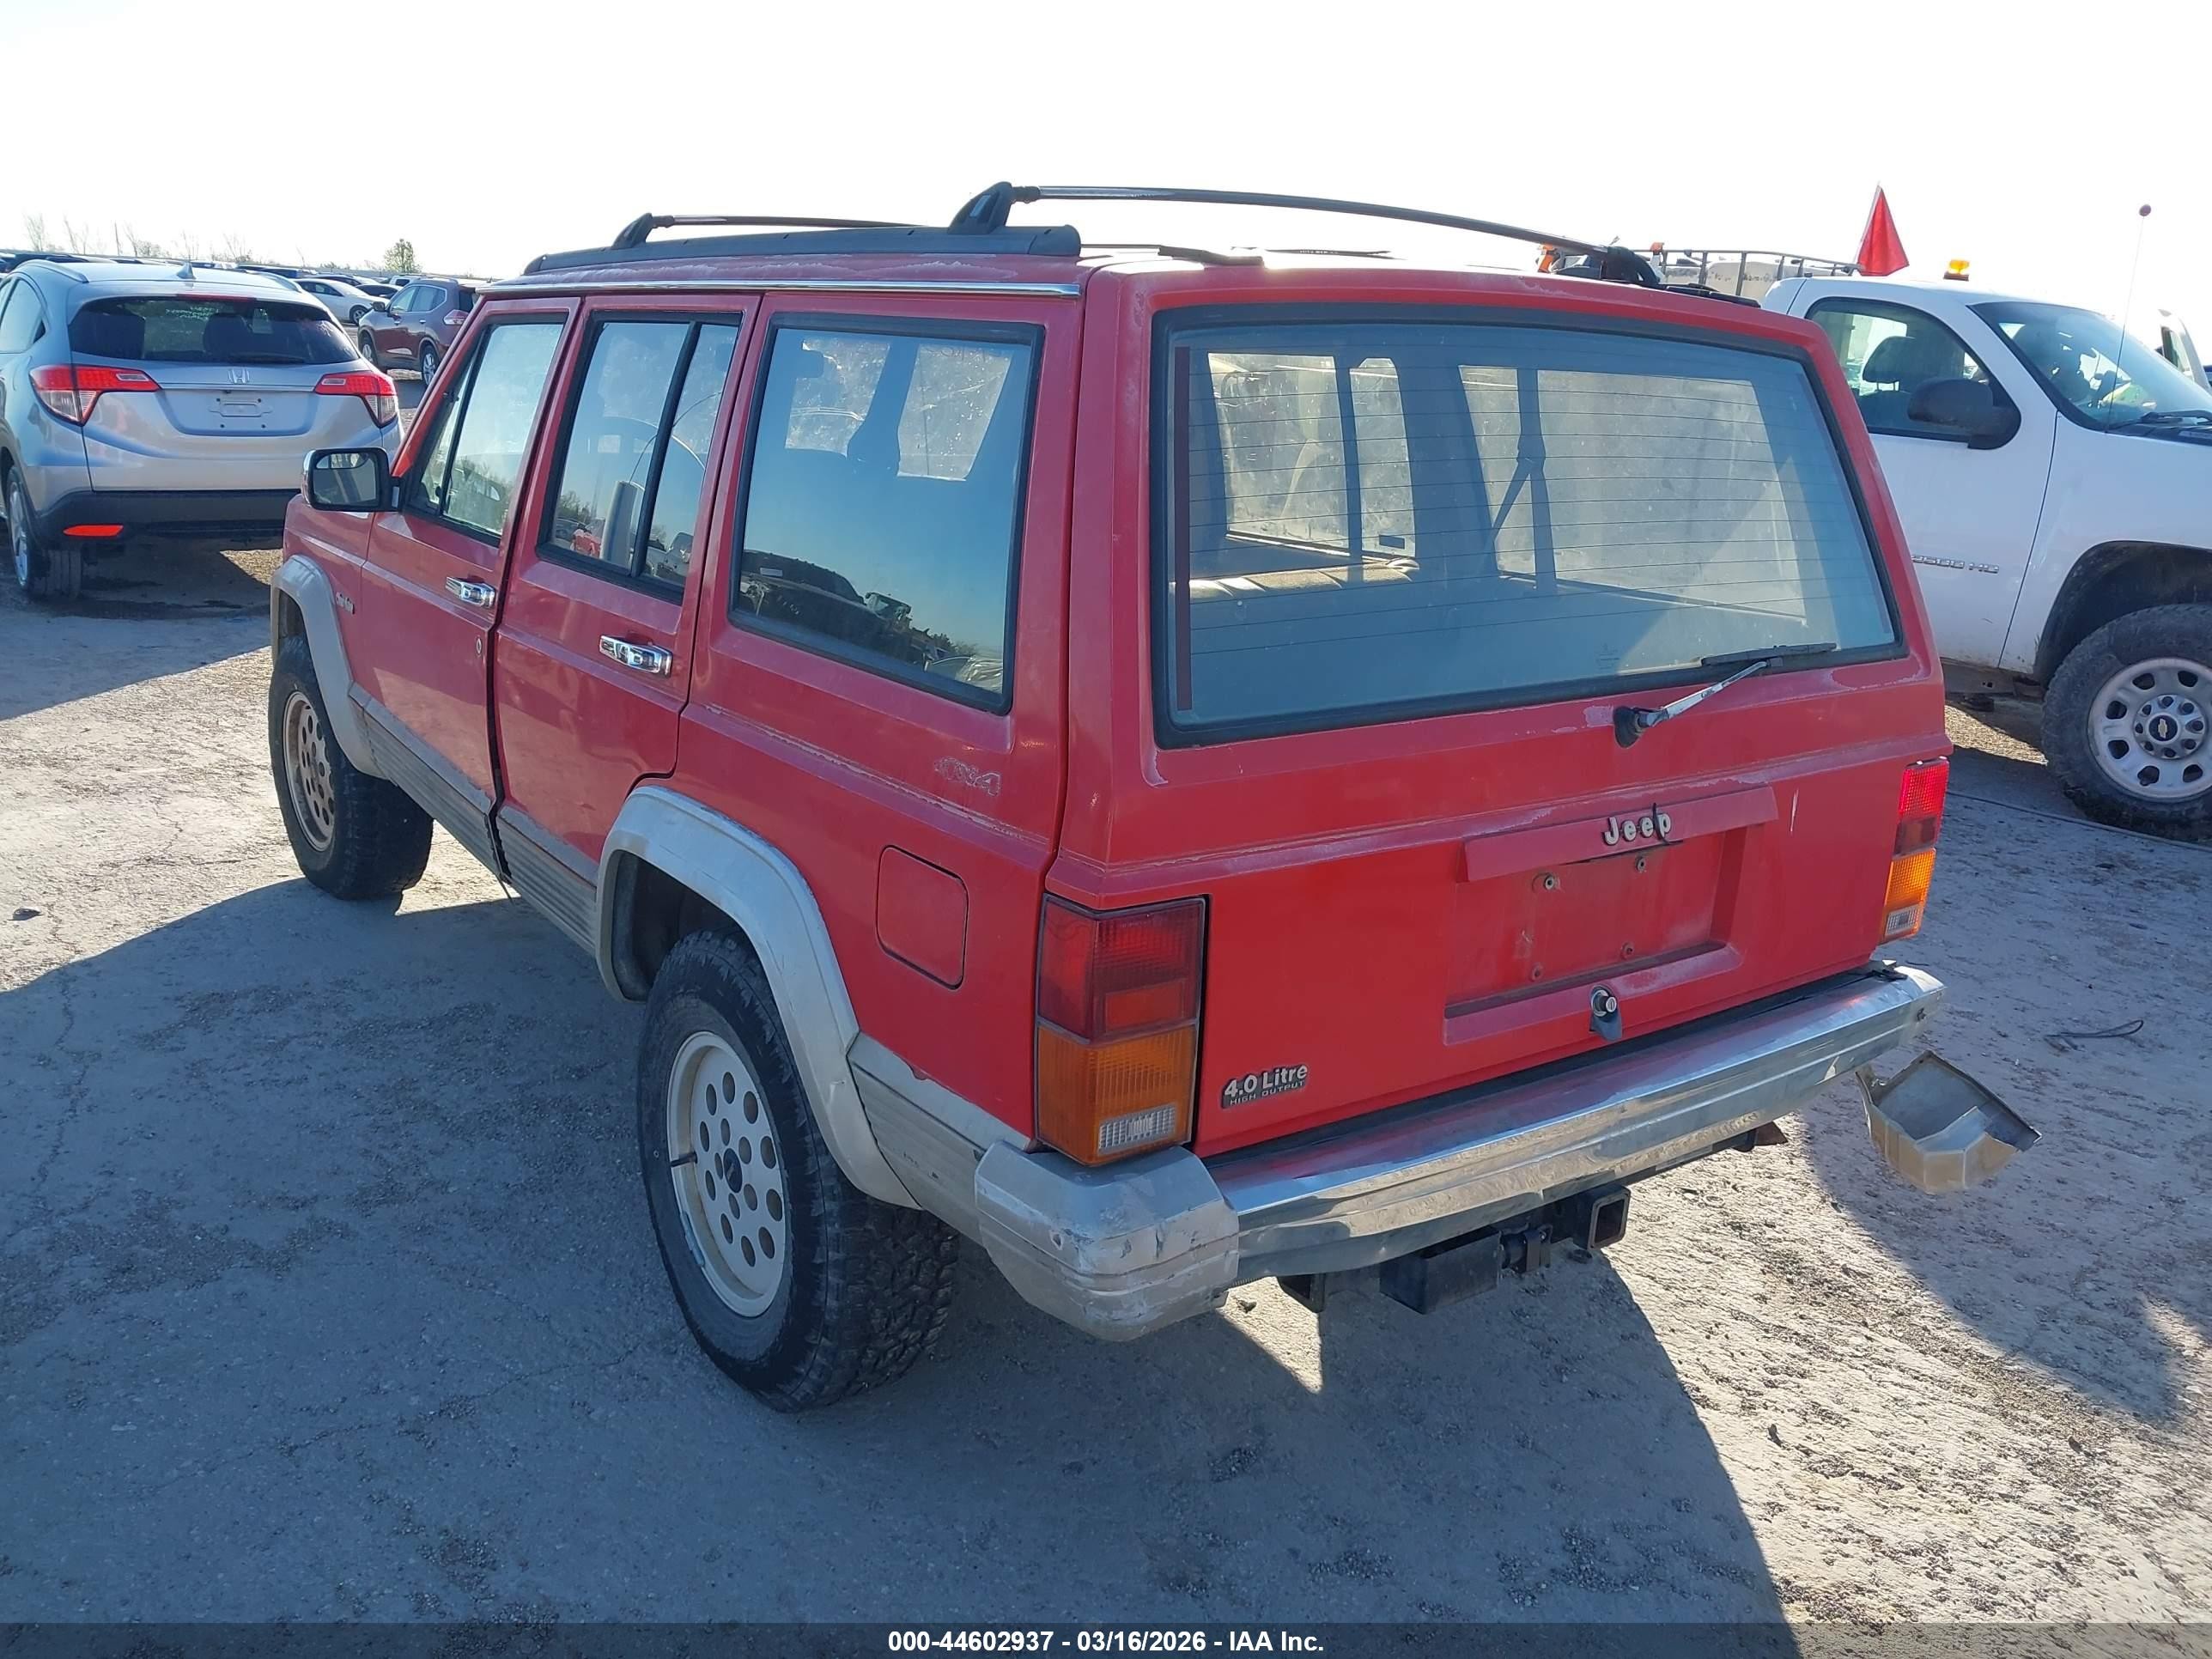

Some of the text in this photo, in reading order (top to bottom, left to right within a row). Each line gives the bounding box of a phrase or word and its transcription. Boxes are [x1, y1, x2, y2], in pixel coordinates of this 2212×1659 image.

[1968, 562, 2000, 574] HD
[1602, 812, 1672, 846] Jeep
[1224, 1065, 1309, 1098] 4.0 Litre
[1230, 1080, 1305, 1106] HIGH OUTPUT
